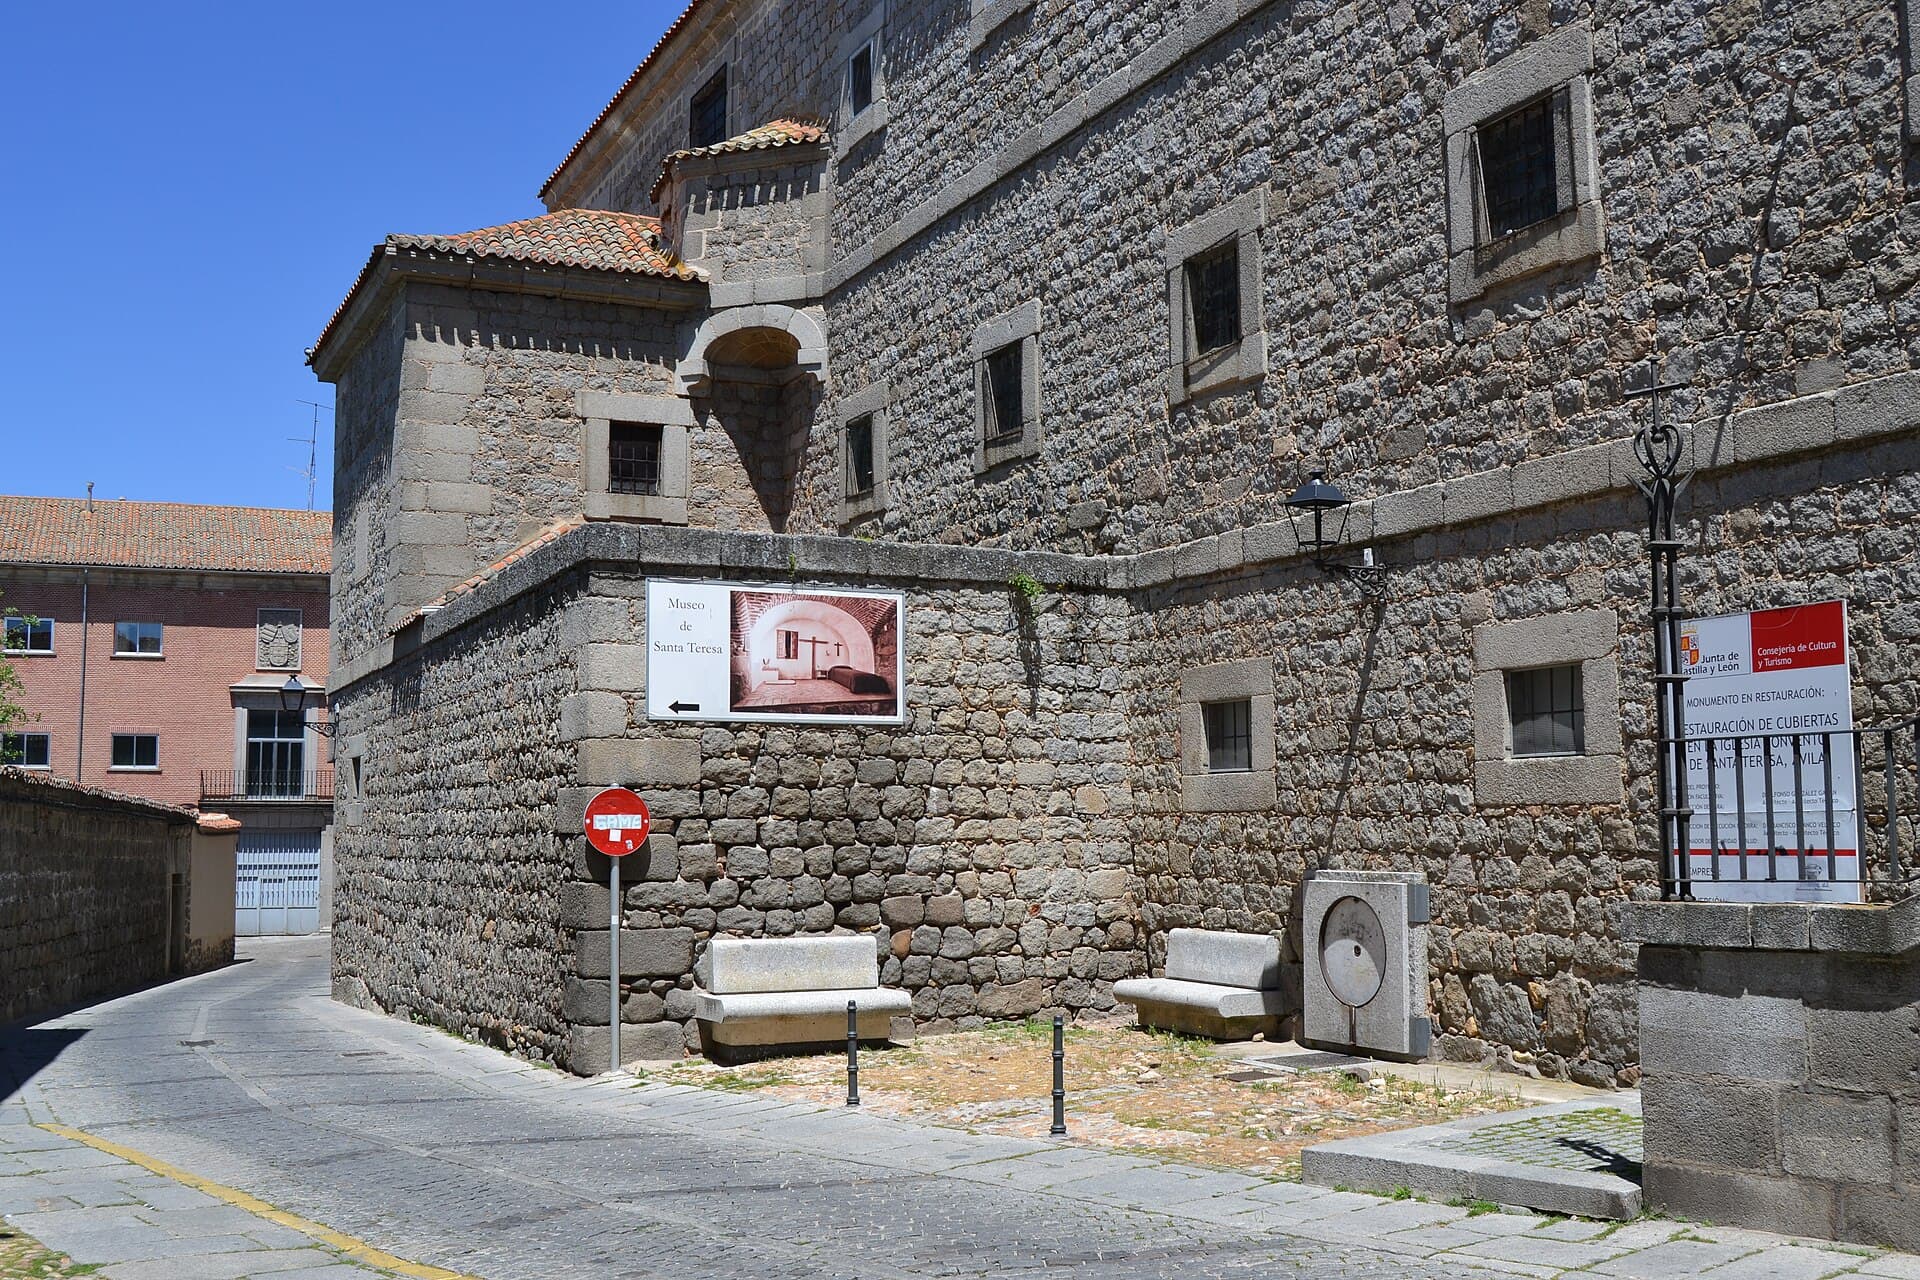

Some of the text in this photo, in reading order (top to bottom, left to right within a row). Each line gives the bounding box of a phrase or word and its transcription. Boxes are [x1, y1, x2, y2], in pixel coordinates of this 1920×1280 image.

[667, 597, 705, 610] Museo
[679, 620, 693, 631] de
[653, 640, 723, 654] Santa Teresa
[1797, 643, 1807, 652] de
[1808, 640, 1837, 651] Cultura
[1700, 651, 1740, 664] Junta de
[1757, 657, 1792, 669] y Turismo
[1683, 661, 1740, 676] astilla y León
[1687, 685, 1825, 708] MONUMENTO EN RESTAURACIÓN:
[1684, 712, 1839, 736] ESTAURACIÓN DE CUBIERTAS
[1689, 758, 1703, 770] DE
[1742, 753, 1788, 768] TERSA,
